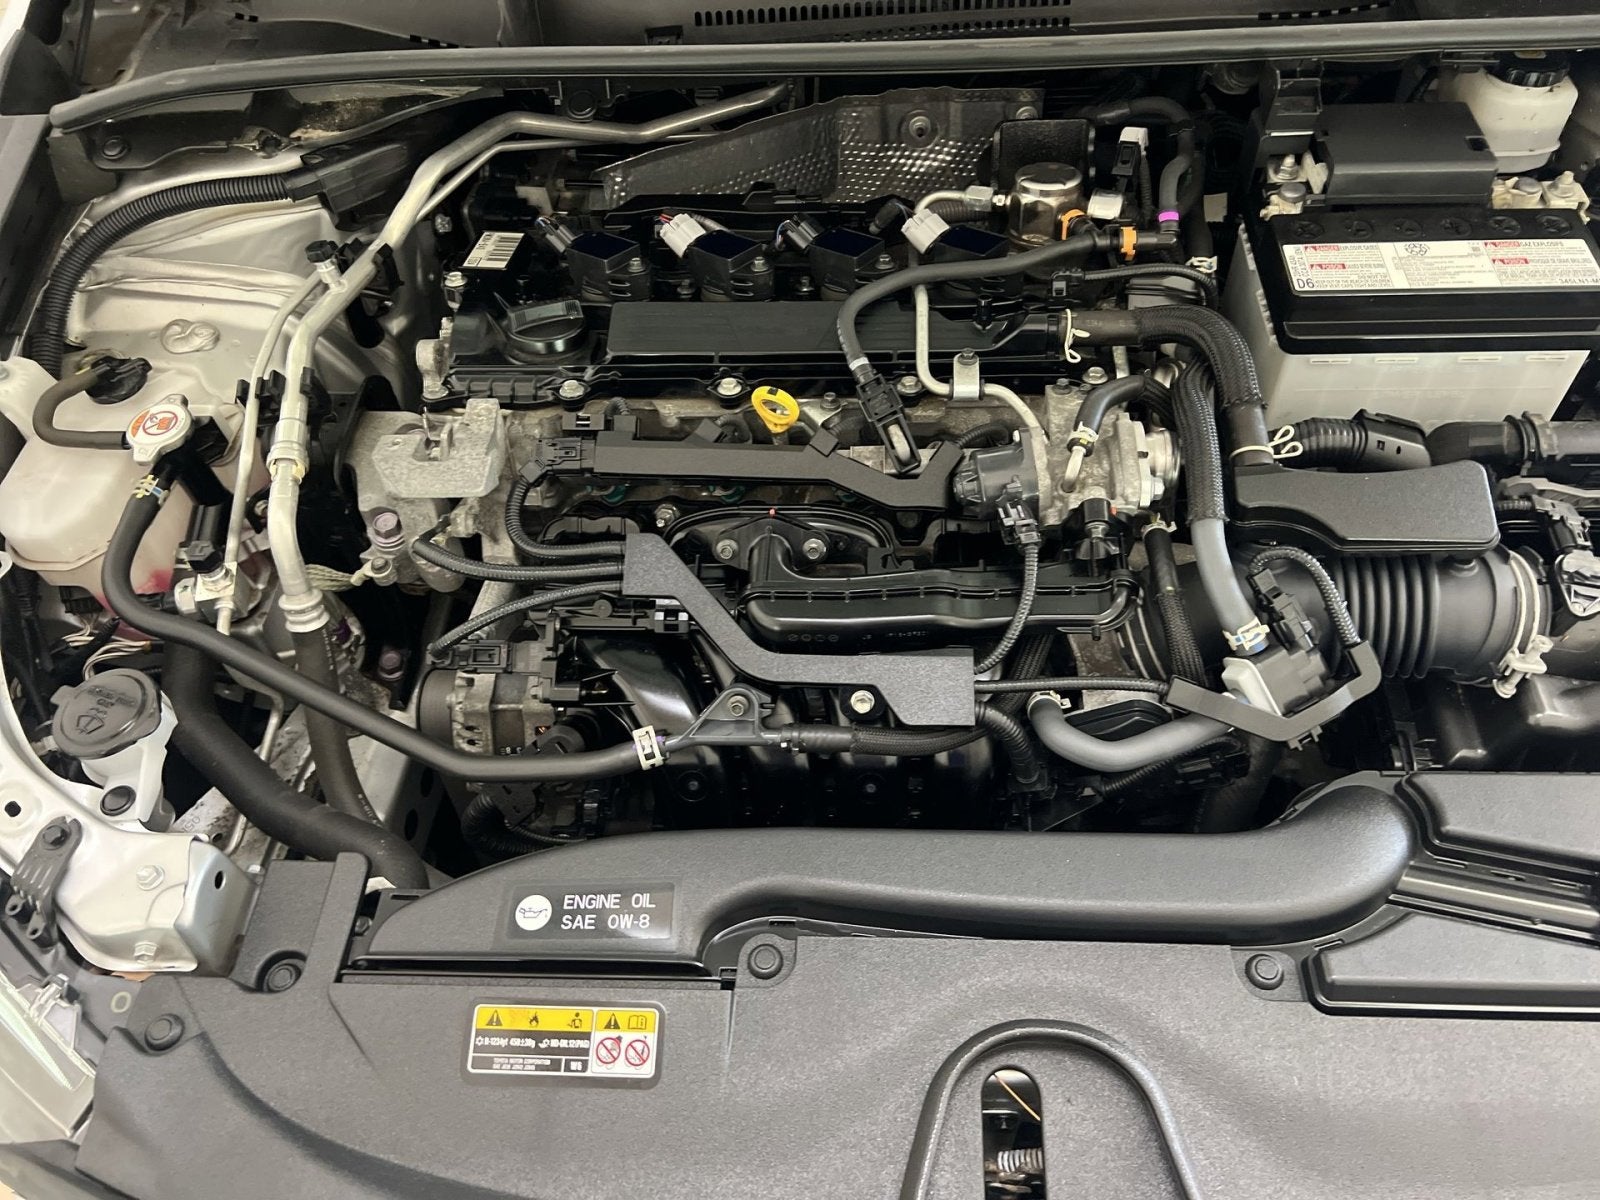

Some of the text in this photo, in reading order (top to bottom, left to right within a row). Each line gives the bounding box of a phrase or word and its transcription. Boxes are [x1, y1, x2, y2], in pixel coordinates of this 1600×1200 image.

[1297, 278, 1315, 289] D6
[563, 893, 656, 910] ENGINE OIL
[560, 913, 650, 930] SAE 0W-8
